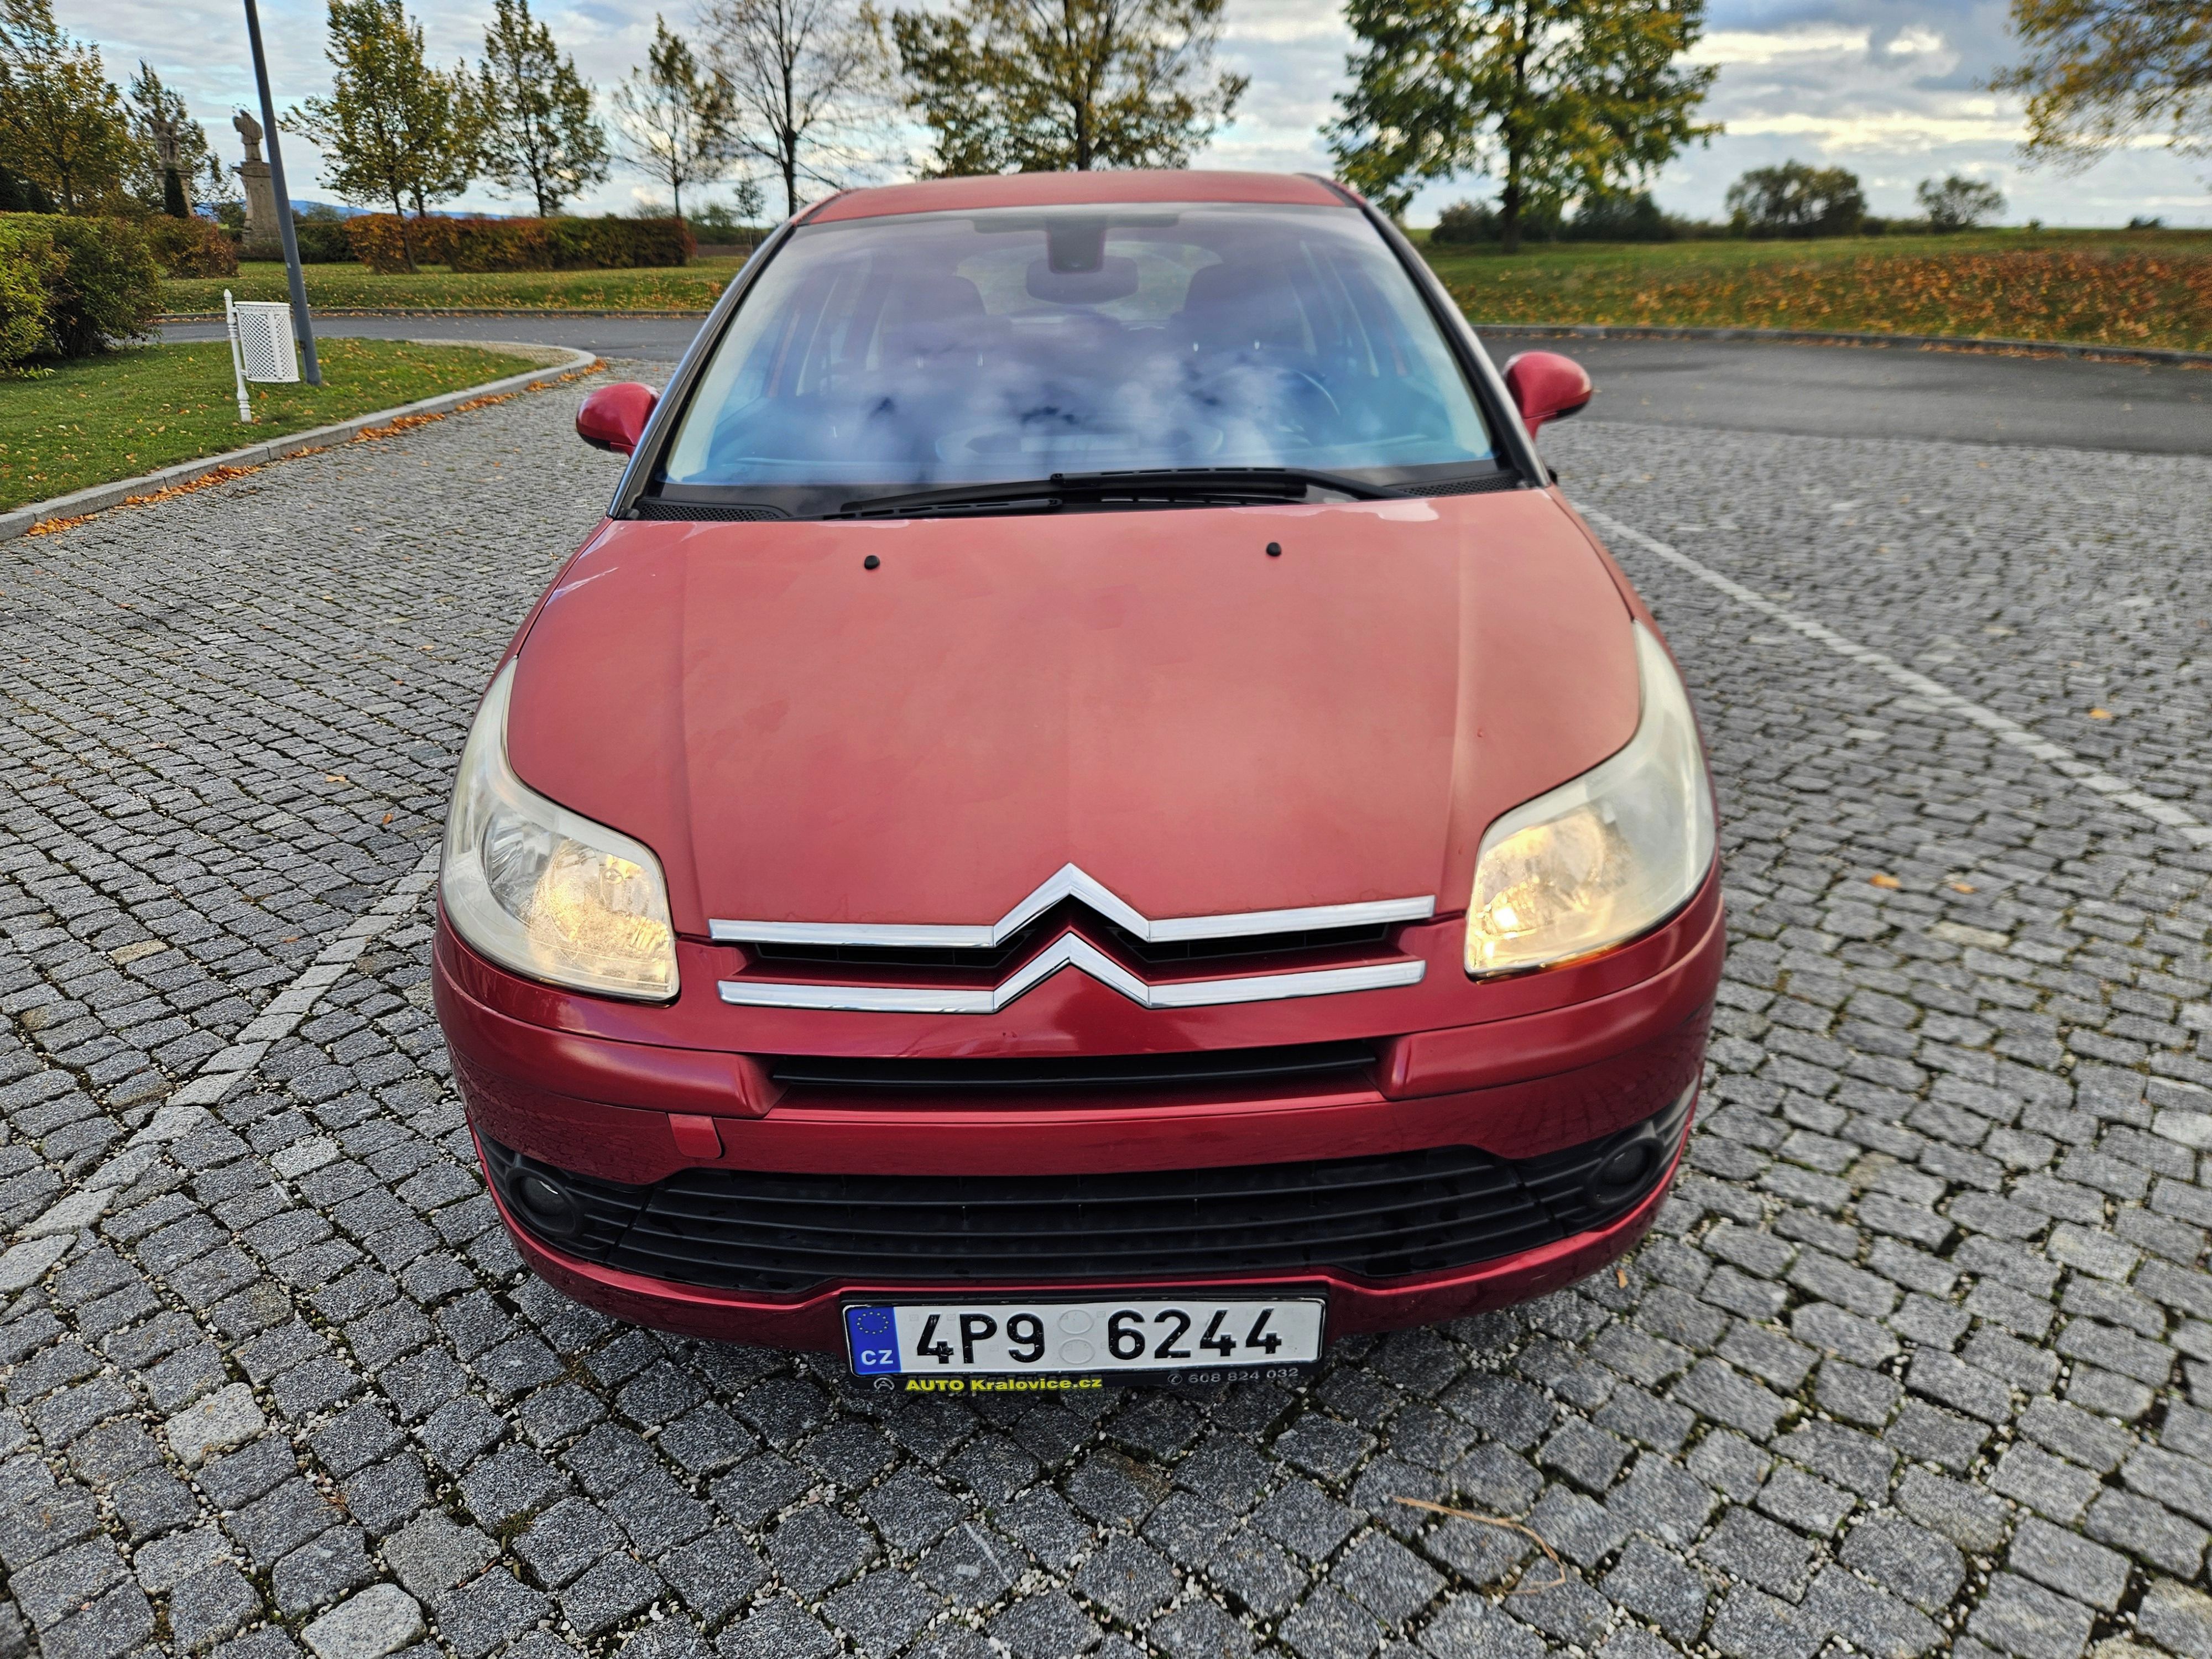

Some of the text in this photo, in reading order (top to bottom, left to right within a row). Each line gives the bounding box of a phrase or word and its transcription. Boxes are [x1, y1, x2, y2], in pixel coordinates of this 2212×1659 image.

[917, 1307, 1282, 1364] 4P9 6244
[861, 1349, 894, 1365] CZ
[1188, 1368, 1299, 1383] 608 824 032
[905, 1378, 1103, 1391] AUTO Kralovice.cz
